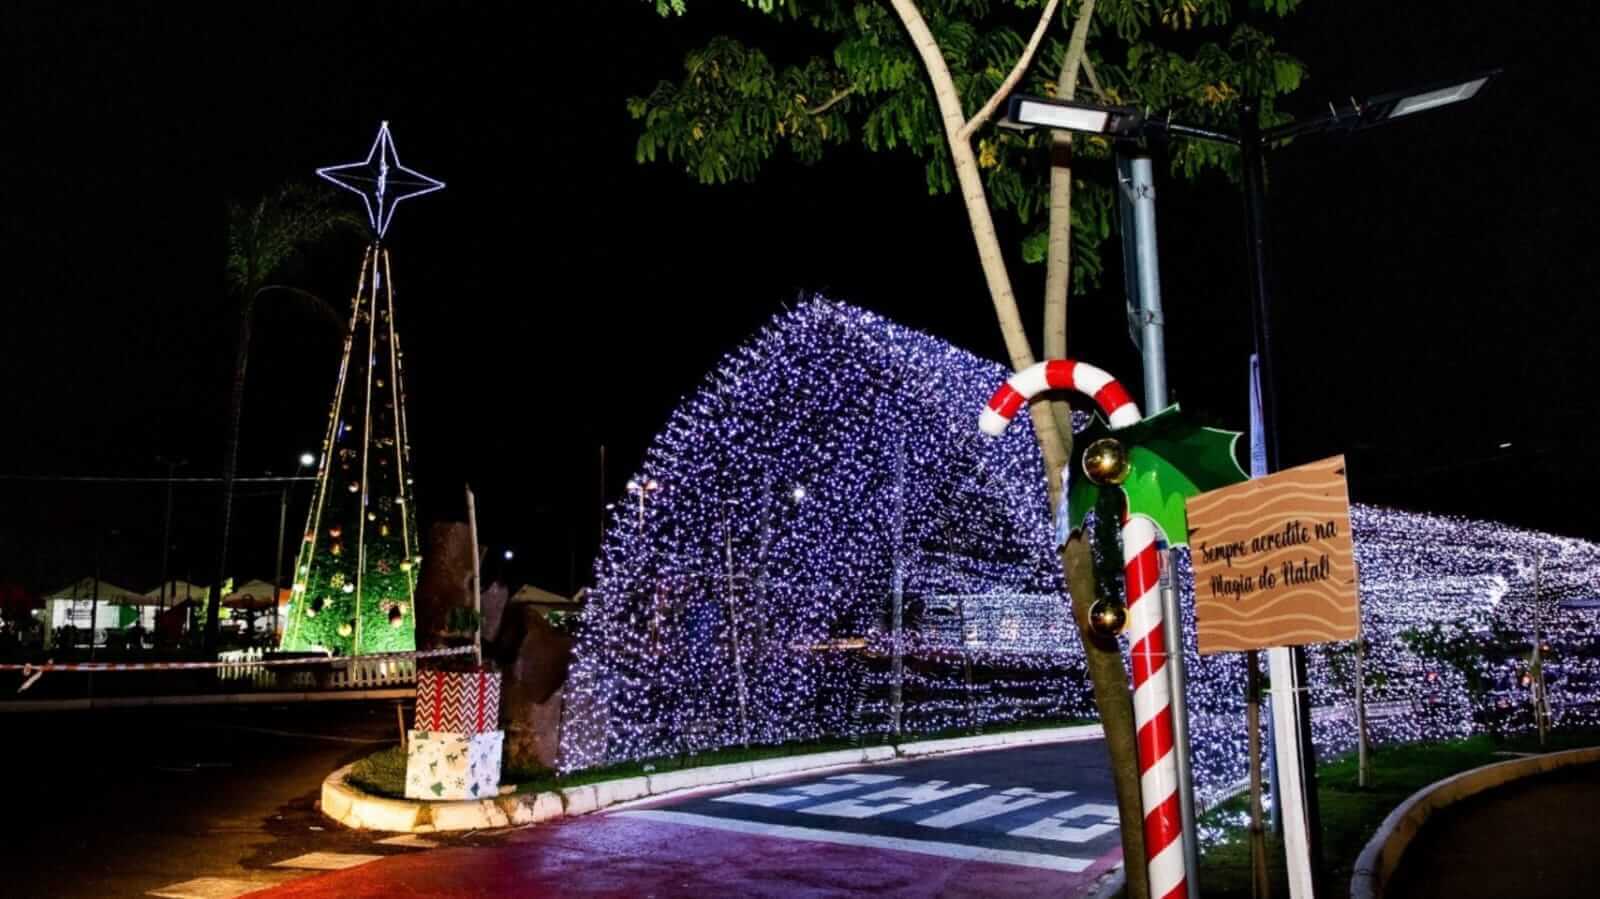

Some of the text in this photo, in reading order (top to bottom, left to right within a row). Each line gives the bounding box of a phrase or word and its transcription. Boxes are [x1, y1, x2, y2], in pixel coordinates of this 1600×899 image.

[1200, 520, 1337, 567] Sempre acredite na
[1210, 575, 1254, 601] Magia
[1258, 566, 1275, 589] do
